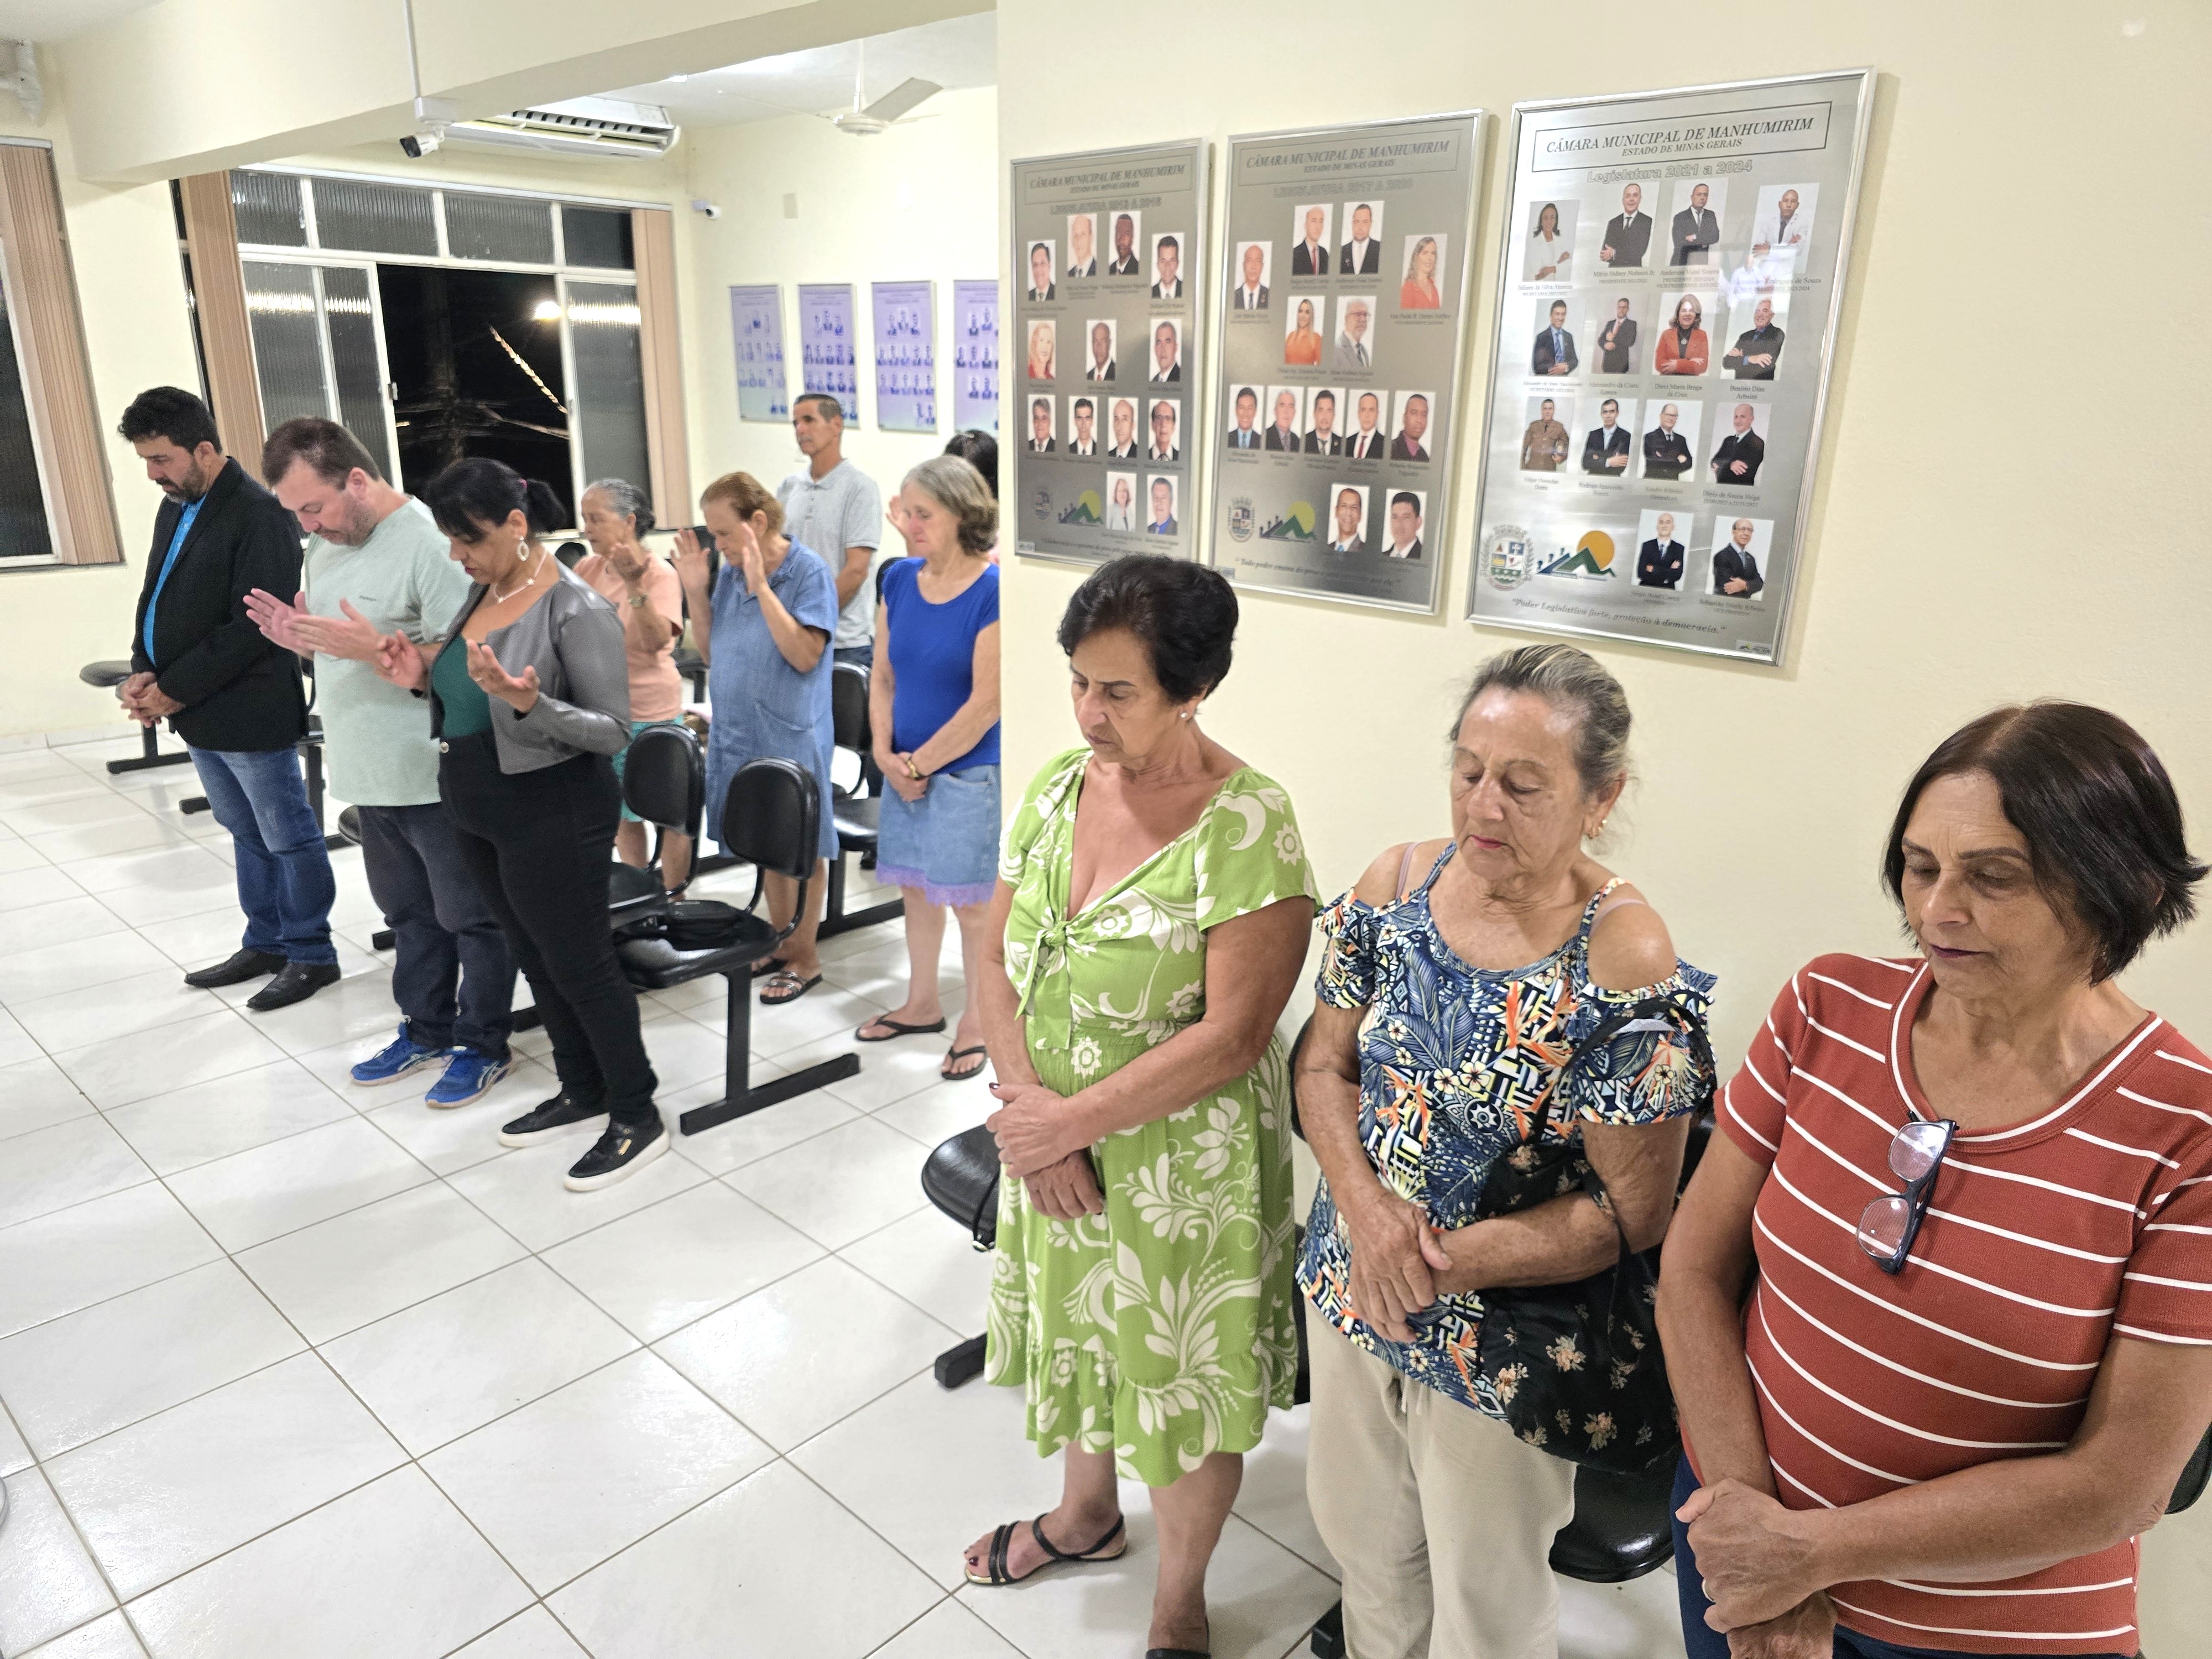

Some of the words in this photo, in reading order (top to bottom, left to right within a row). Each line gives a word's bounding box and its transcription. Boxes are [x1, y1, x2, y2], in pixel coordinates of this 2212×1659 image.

[1601, 130, 1681, 148] MUNICIPAL
[1686, 128, 1705, 141] DE
[1707, 117, 1814, 139] MANHUMIRIM
[1291, 149, 1347, 165] MUNICIPAL
[1350, 148, 1367, 159] DE
[1369, 140, 1451, 158] MANHUMIRIM
[1621, 146, 1658, 156] ESTADO
[1660, 144, 1673, 153] DE
[1674, 142, 1705, 152] MINAS
[1707, 139, 1743, 149] GERAIS
[1063, 172, 1108, 186] MUNICIPAL
[1110, 170, 1123, 181] DE
[1124, 164, 1186, 180] MANHUMIRIM
[1303, 164, 1332, 174] ESTADO
[1368, 159, 1395, 169] GERAIS
[1587, 167, 1662, 184] Legislatura
[1665, 164, 1699, 177] 2021
[1702, 166, 1713, 175] a
[1715, 160, 1752, 175] 2024
